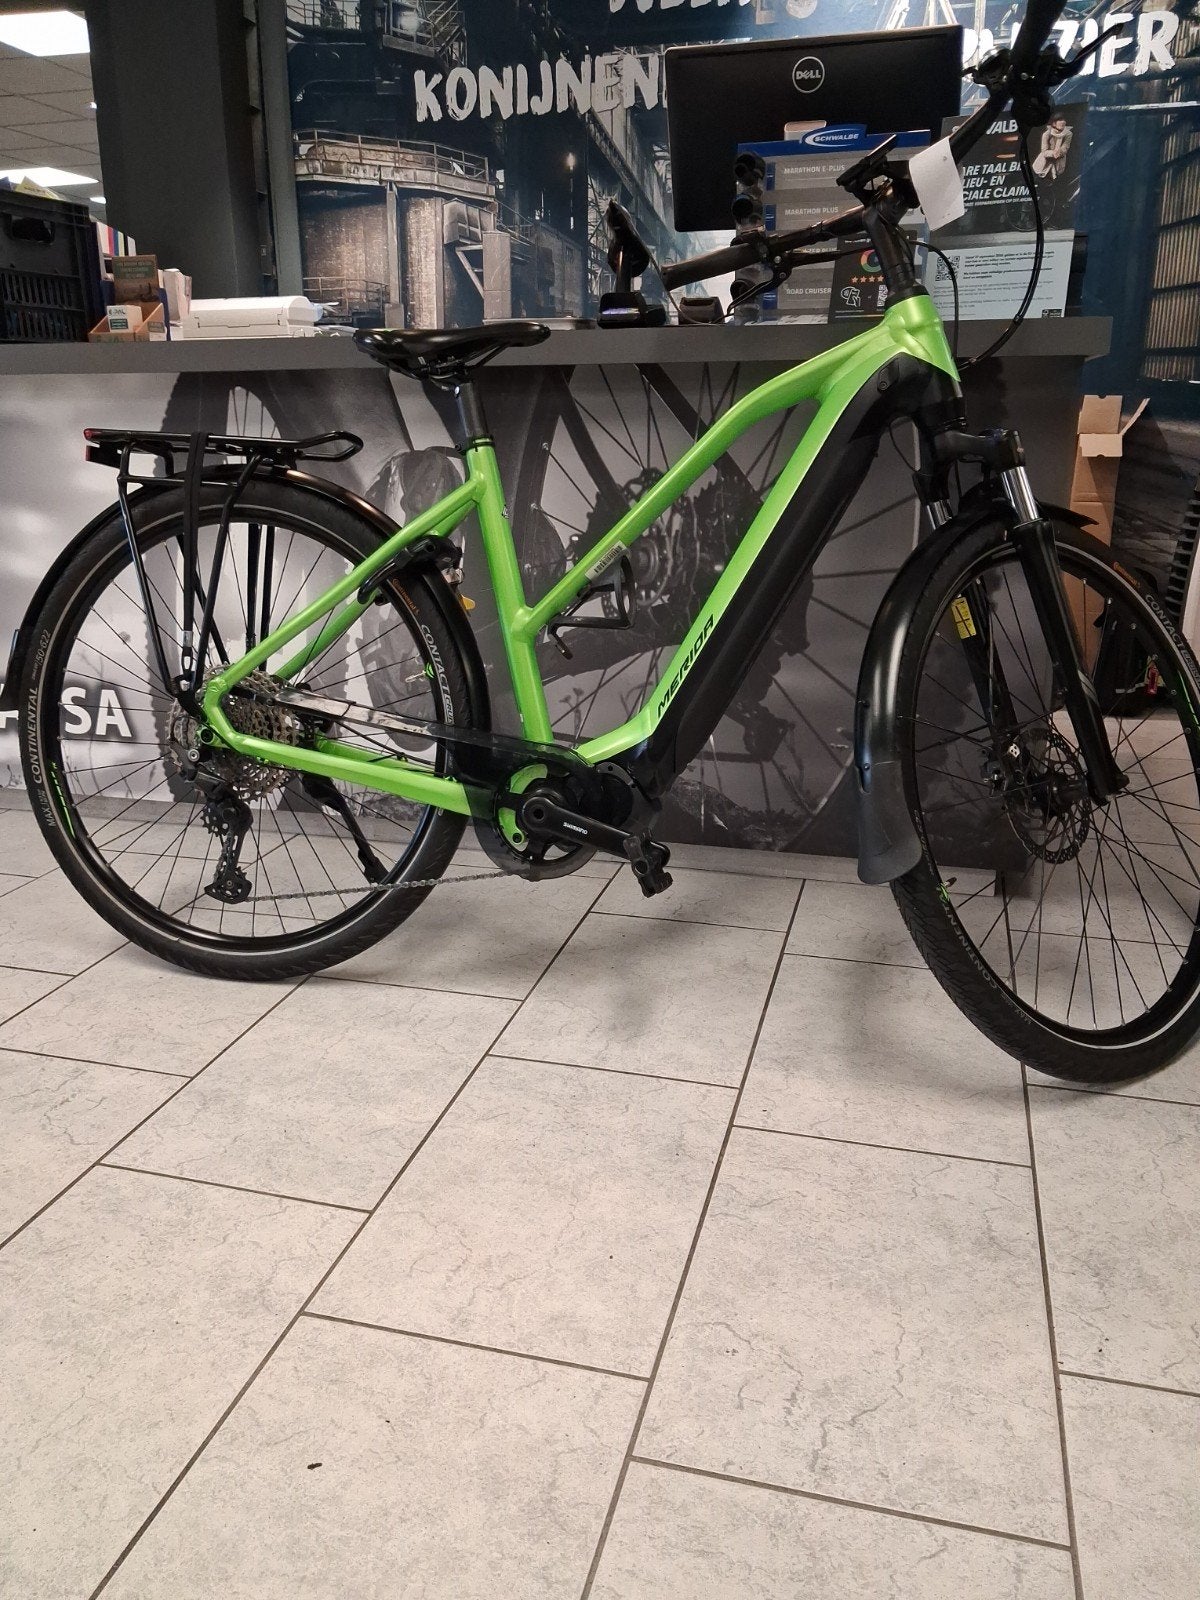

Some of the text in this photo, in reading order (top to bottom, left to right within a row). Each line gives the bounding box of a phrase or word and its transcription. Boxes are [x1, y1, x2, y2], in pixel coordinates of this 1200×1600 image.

[796, 70, 821, 80] DELL
[413, 52, 667, 122] KONIJNEN
[814, 133, 859, 142] SCHWALBE
[784, 164, 846, 174] MARATHON E-PLUS
[981, 163, 1007, 175] TAAL
[962, 175, 1006, 189] LIEU- EN
[962, 185, 1032, 201] CIALE CLAIM
[785, 206, 840, 216] MARATHON PLUS
[806, 287, 832, 295] CRUISER
[1145, 594, 1185, 650] CONTACT
[421, 624, 451, 695] CONTACT
[657, 614, 715, 719] MERIDA
[27, 687, 43, 784] CONTINENTAL
